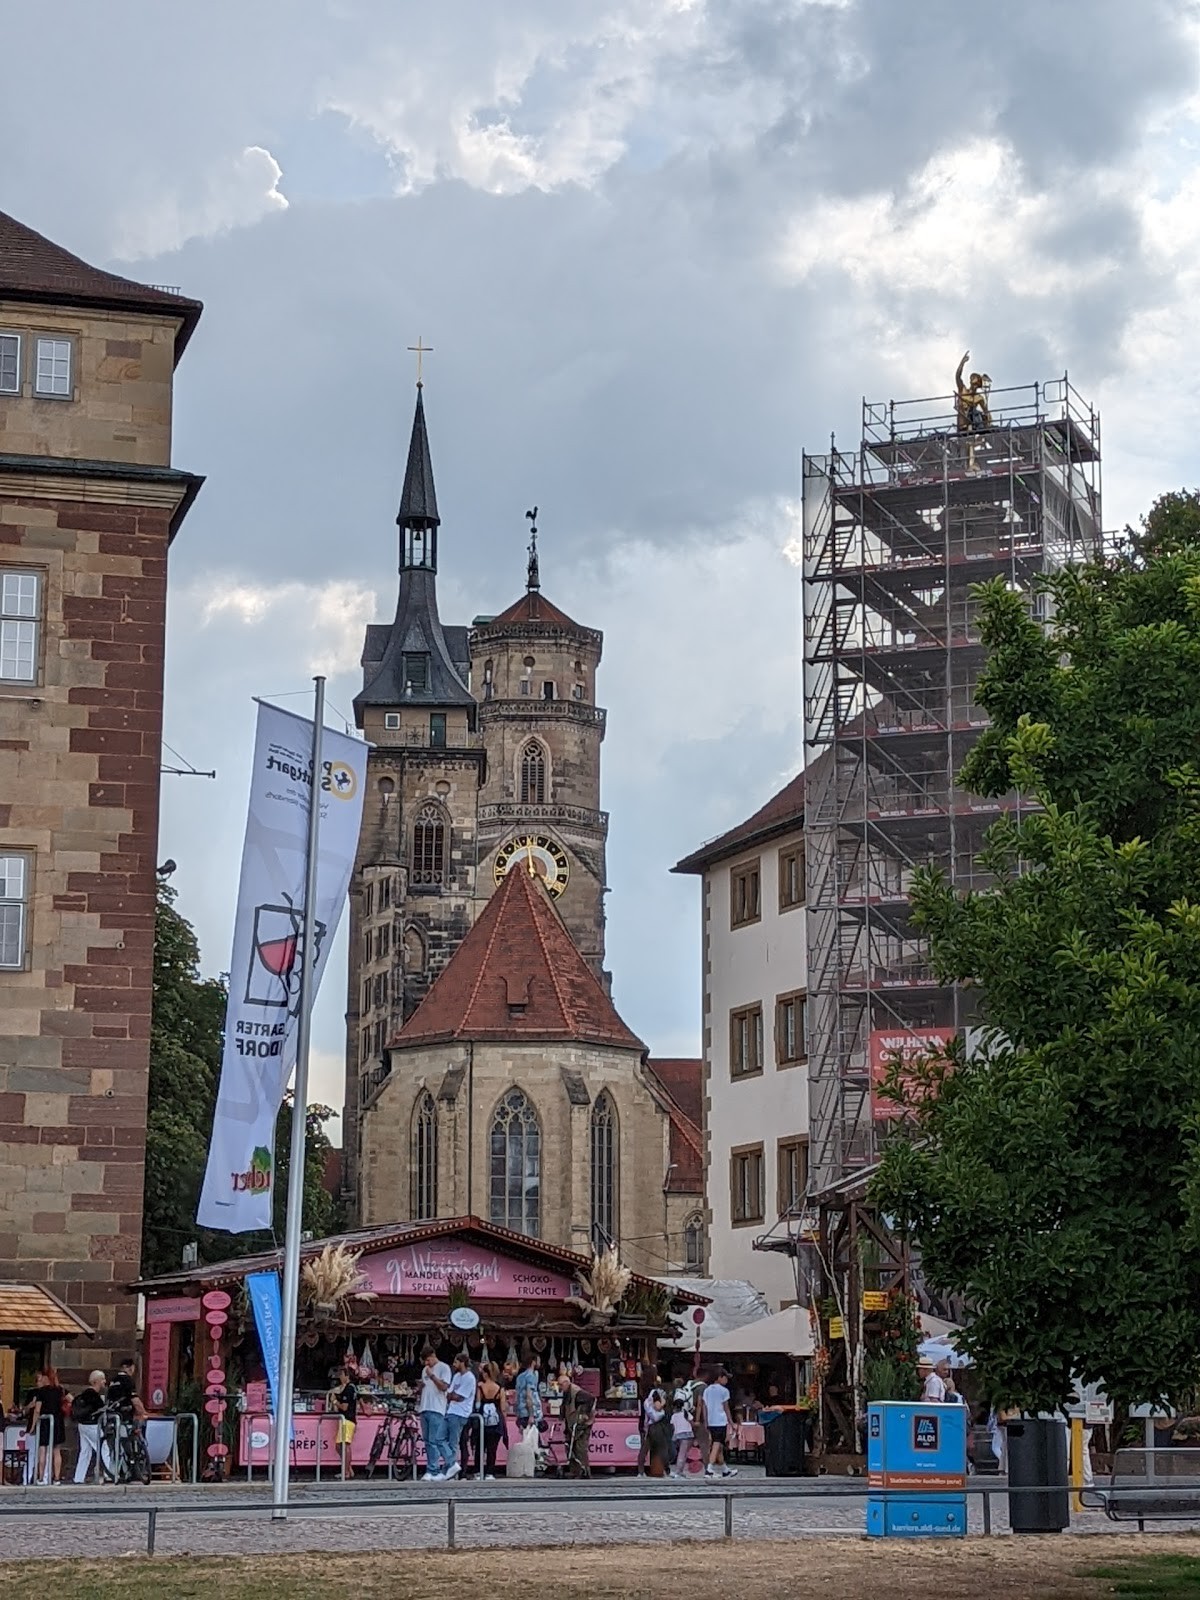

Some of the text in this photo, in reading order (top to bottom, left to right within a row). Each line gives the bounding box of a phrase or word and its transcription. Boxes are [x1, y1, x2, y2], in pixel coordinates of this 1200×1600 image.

[456, 1272, 480, 1281] NUSS
[512, 1273, 553, 1284] SCHOKO-
[916, 1435, 936, 1443] ALDI
